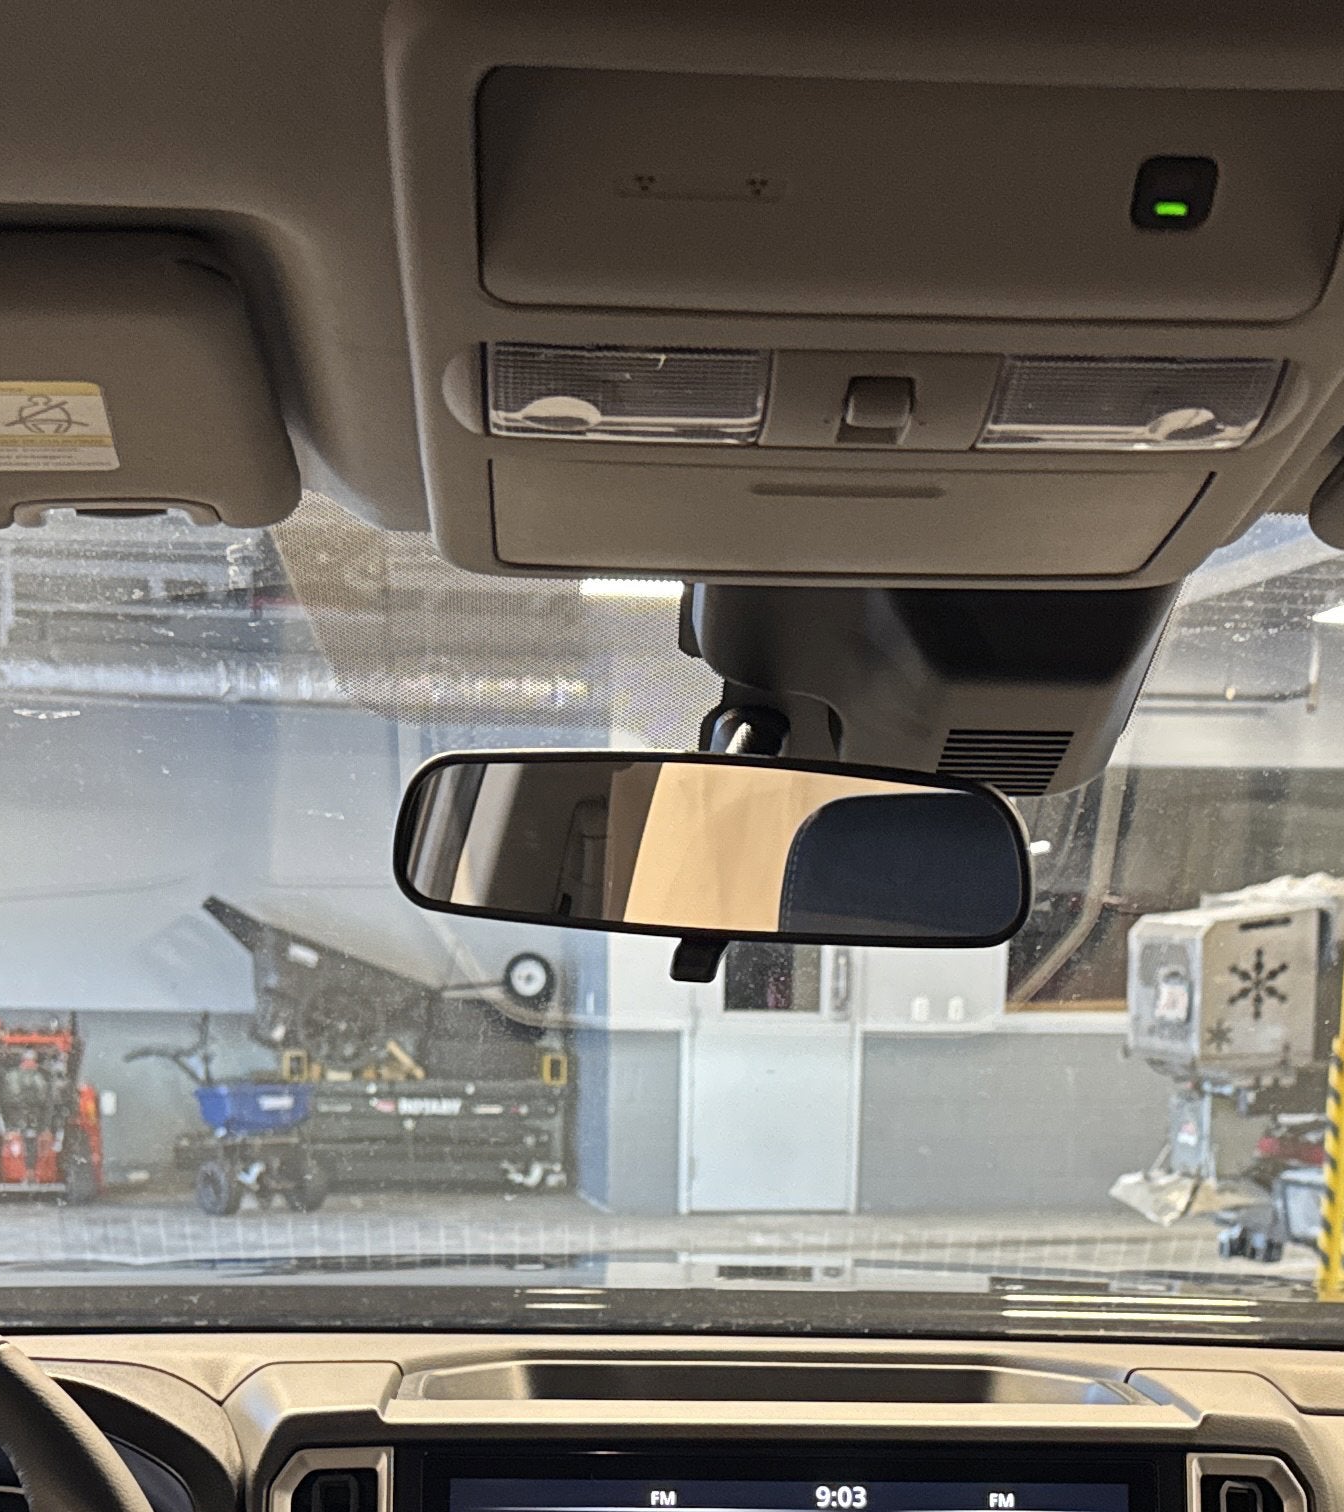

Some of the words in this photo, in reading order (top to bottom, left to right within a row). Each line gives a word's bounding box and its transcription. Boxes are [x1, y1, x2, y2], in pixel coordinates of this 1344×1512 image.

[650, 1490, 677, 1506] FM
[815, 1485, 867, 1509] 9:03
[989, 1492, 1015, 1508] FM
